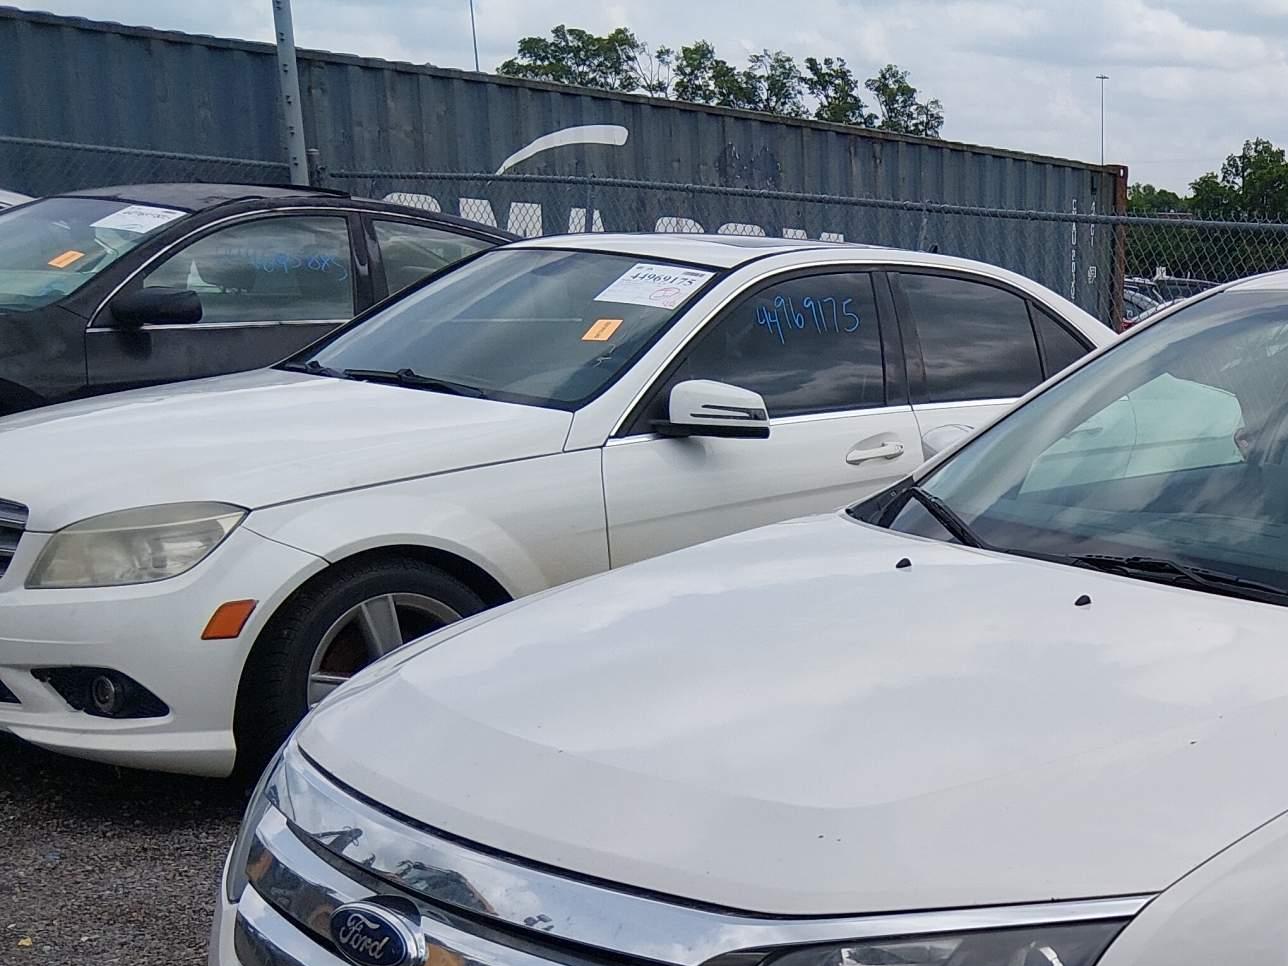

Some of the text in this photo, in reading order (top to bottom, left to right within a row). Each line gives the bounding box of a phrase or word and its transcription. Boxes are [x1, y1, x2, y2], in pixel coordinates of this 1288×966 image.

[630, 271, 697, 287] 44969175
[756, 295, 860, 345] 44969175
[339, 913, 389, 959] Ford
